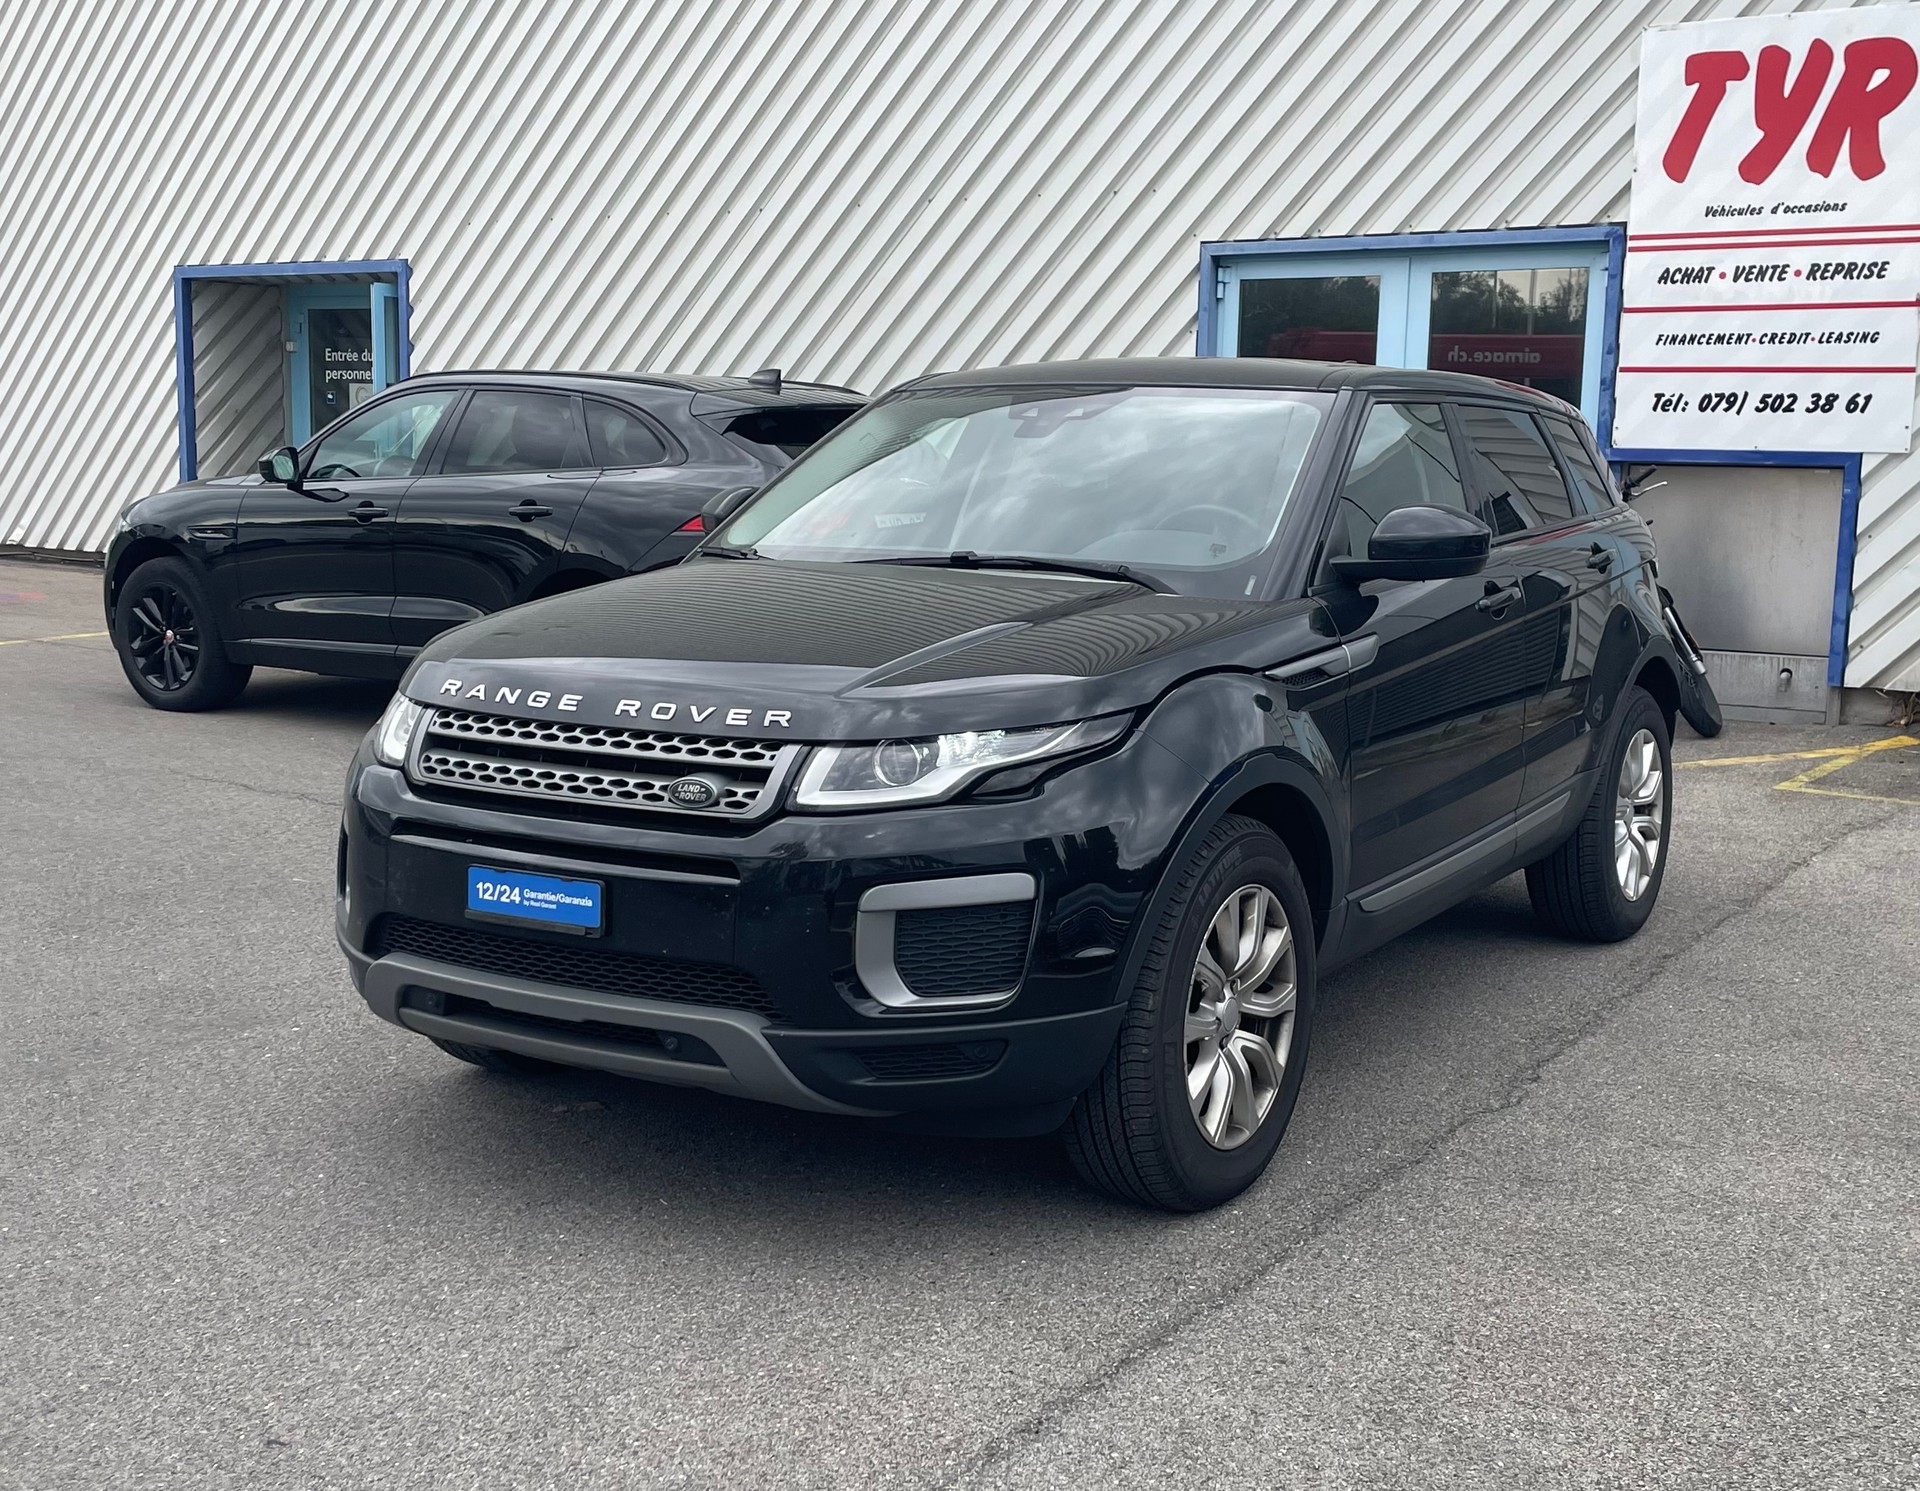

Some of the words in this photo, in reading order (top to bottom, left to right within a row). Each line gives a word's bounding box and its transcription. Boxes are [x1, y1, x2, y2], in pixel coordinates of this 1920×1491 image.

[1662, 37, 1919, 185] TYR
[1704, 204, 1764, 218] Véhicules
[1770, 200, 1848, 215] d'occasions
[1657, 266, 1716, 285] ACHAT
[1732, 263, 1791, 283] VENTE
[1805, 261, 1890, 281] REPRISE
[1655, 333, 1752, 346] FINANCEMENT
[1758, 332, 1812, 345] CREDIT
[1818, 331, 1880, 344] LEASING
[325, 347, 359, 362] Entrée
[361, 348, 373, 362] du
[325, 366, 374, 383] personnel
[1651, 392, 1690, 413] Tél:
[1754, 393, 1799, 413] 502
[1805, 393, 1840, 414] 38
[1845, 393, 1873, 414] 61
[440, 679, 584, 711] RANGE
[614, 699, 793, 728] ROVER
[677, 783, 701, 793] LAND
[678, 791, 707, 802] ROVER
[476, 881, 521, 904] 12/24
